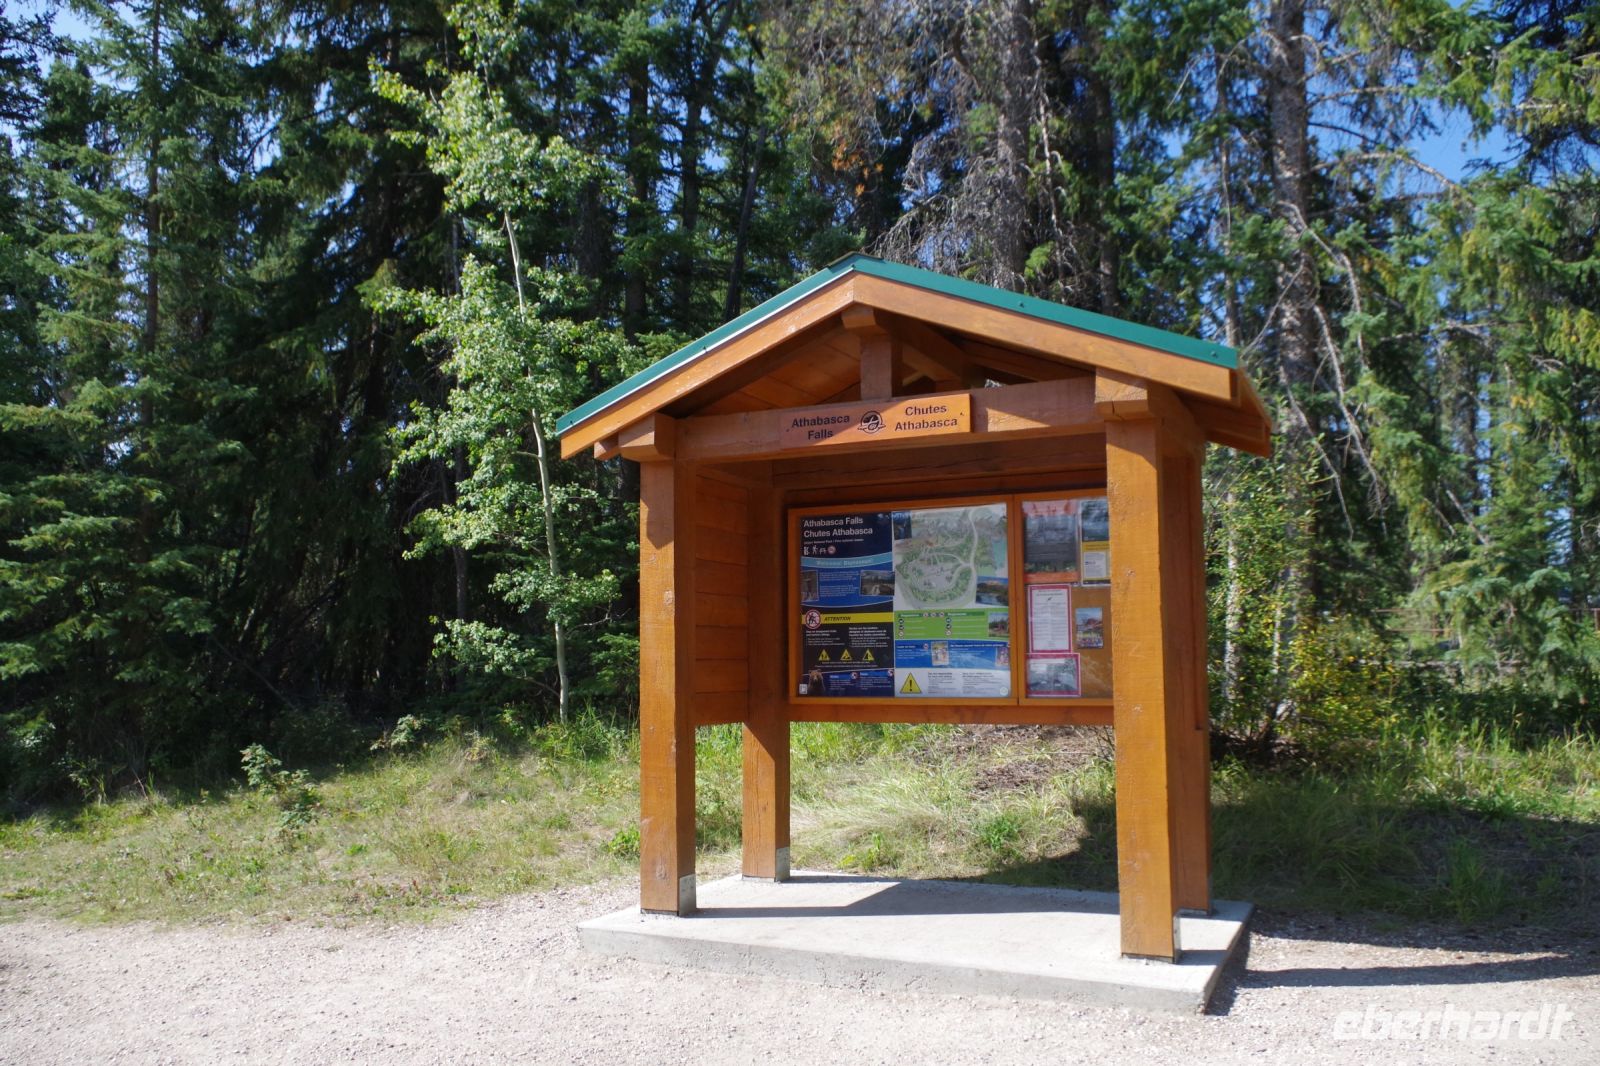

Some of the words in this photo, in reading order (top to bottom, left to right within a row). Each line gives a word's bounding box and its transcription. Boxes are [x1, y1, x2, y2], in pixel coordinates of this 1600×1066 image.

[905, 404, 947, 417] Chutes
[791, 414, 850, 428] Athabasca
[894, 418, 958, 432] Athabasca
[807, 429, 834, 440] Falls
[803, 518, 844, 528] Athabasca
[845, 516, 864, 525] Falls
[803, 529, 831, 538] Chutes
[832, 527, 873, 537] Athabasca
